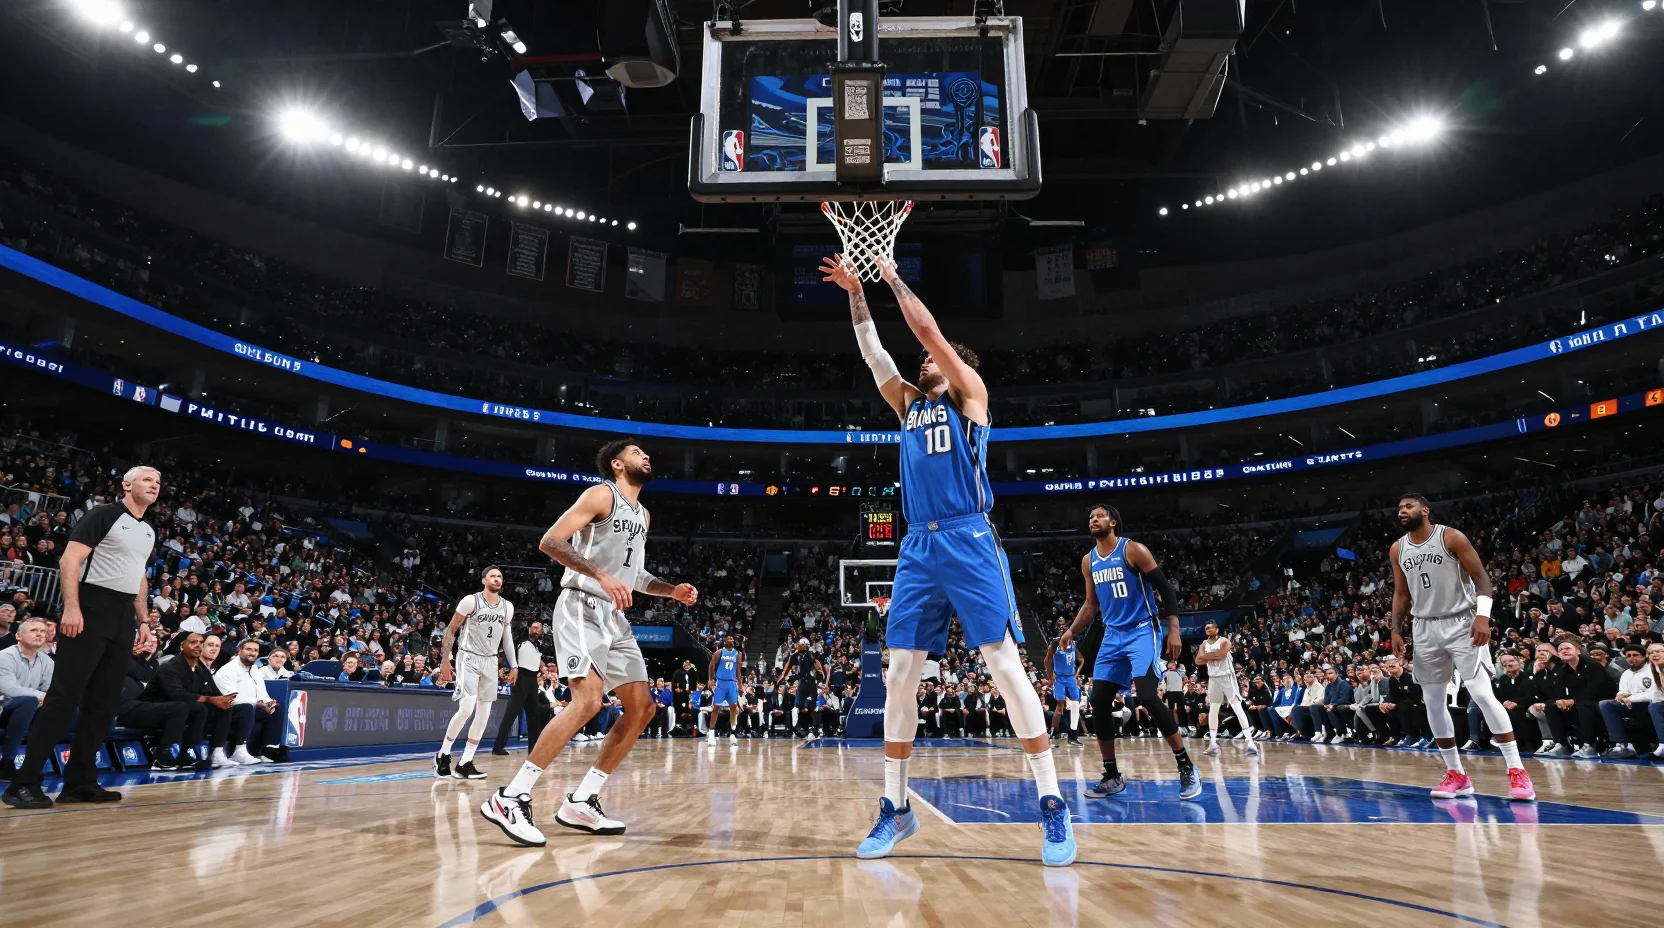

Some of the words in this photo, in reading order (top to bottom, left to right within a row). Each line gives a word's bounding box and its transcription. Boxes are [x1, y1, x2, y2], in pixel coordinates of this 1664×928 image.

[924, 424, 952, 455] 10
[622, 547, 634, 568] 1
[1110, 581, 1128, 599] 10
